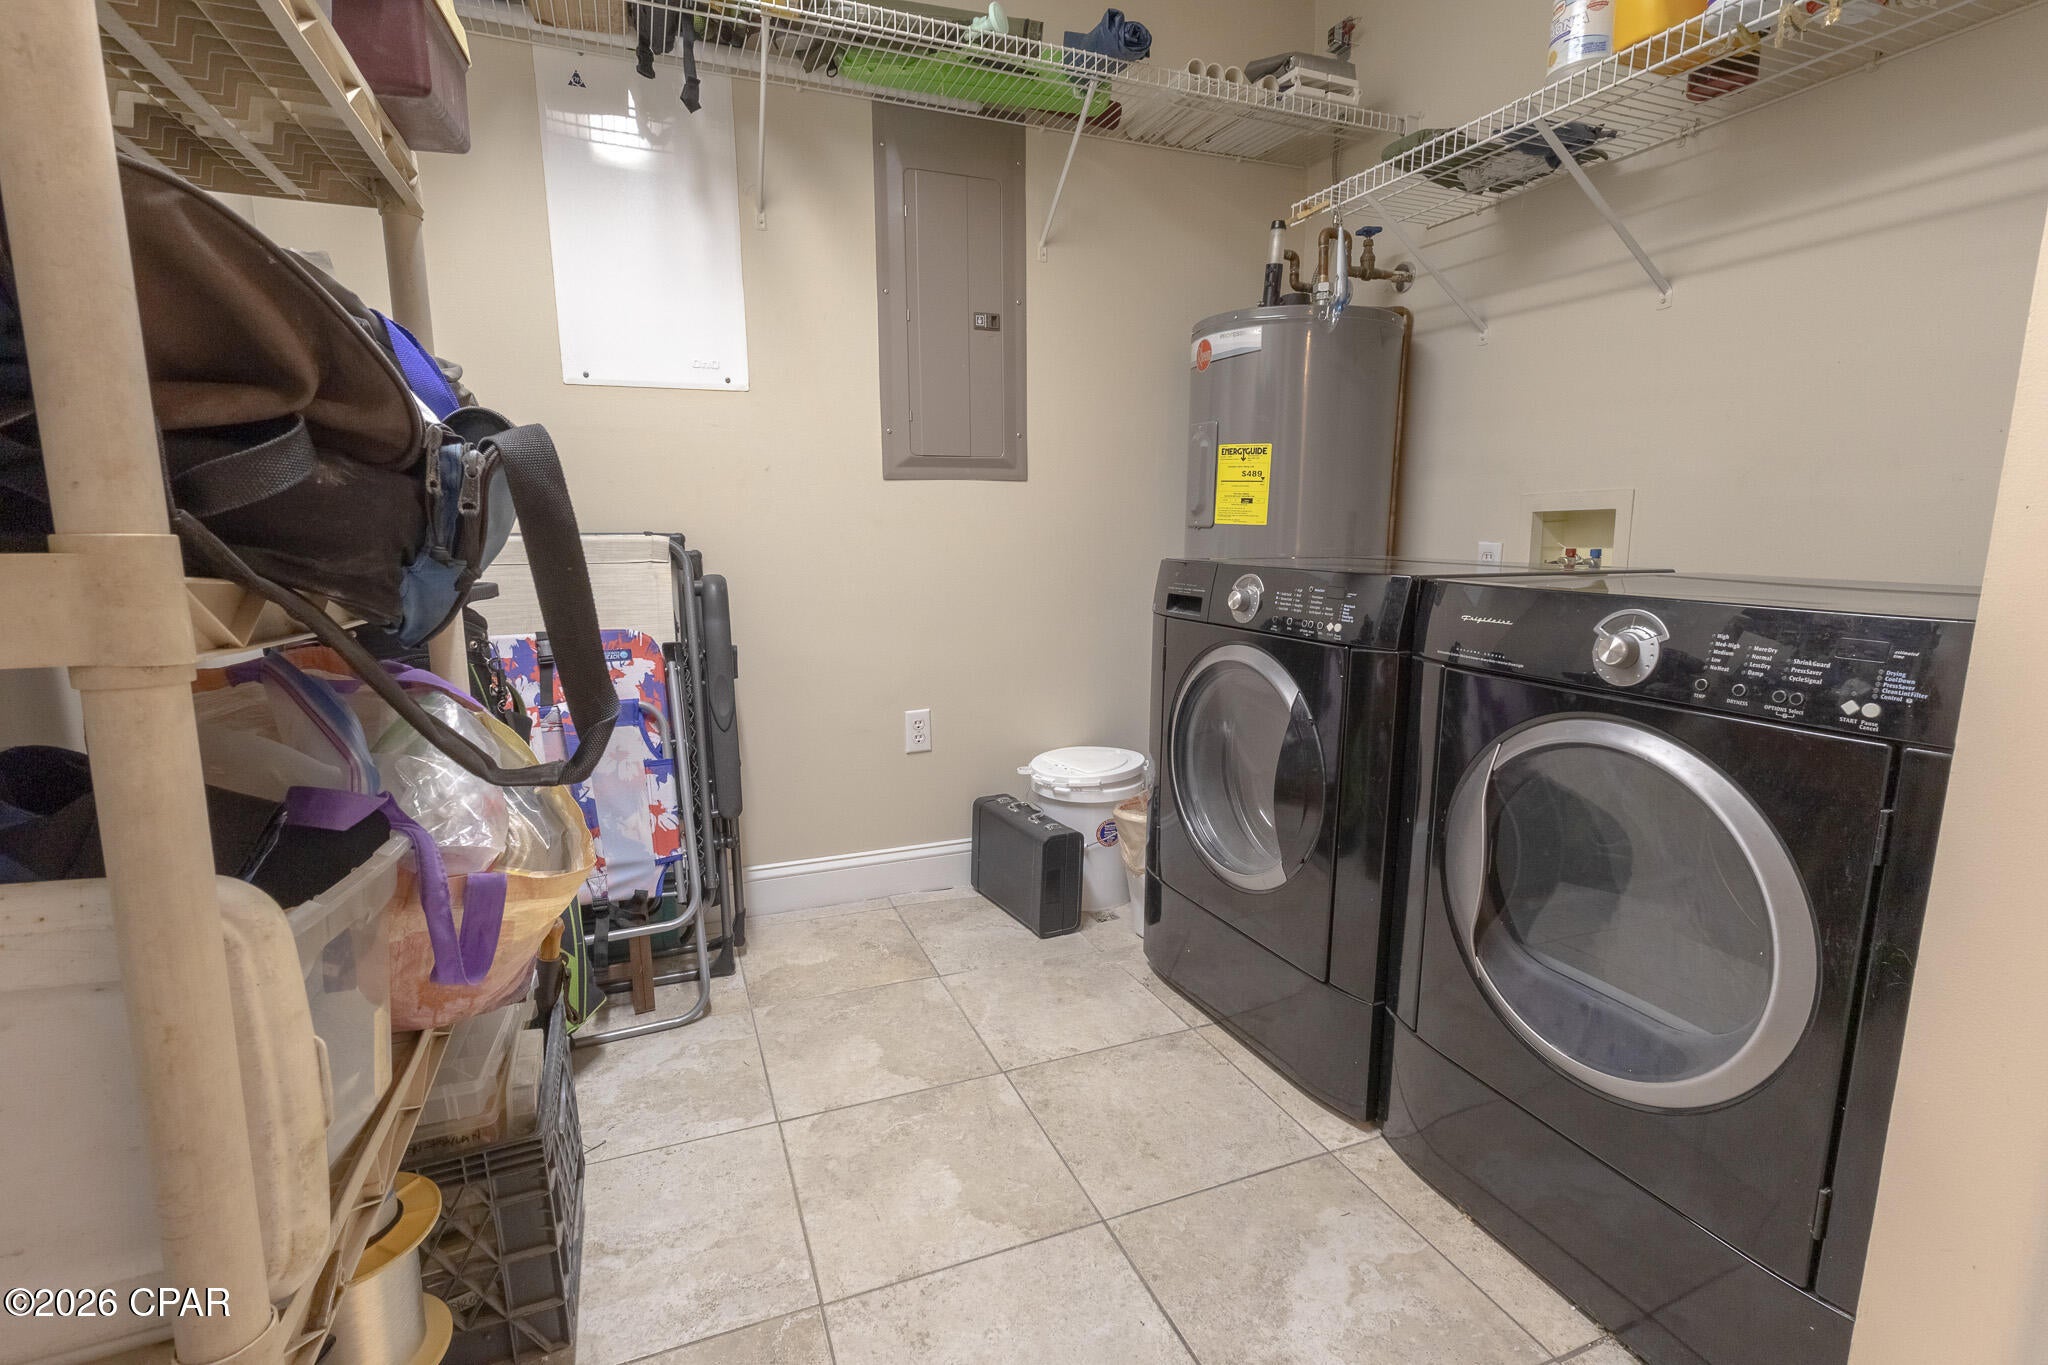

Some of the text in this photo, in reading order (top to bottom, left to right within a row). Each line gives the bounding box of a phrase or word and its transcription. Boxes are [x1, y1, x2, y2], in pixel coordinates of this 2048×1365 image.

[1241, 470, 1263, 478] $489
[1751, 653, 1773, 662] Normal
[1747, 669, 1764, 678] Damp
[1886, 670, 1906, 678] Drying
[1726, 698, 1749, 707] DRYNESS
[1880, 694, 1903, 702] Control
[1764, 704, 1805, 716] OPTIONS Select
